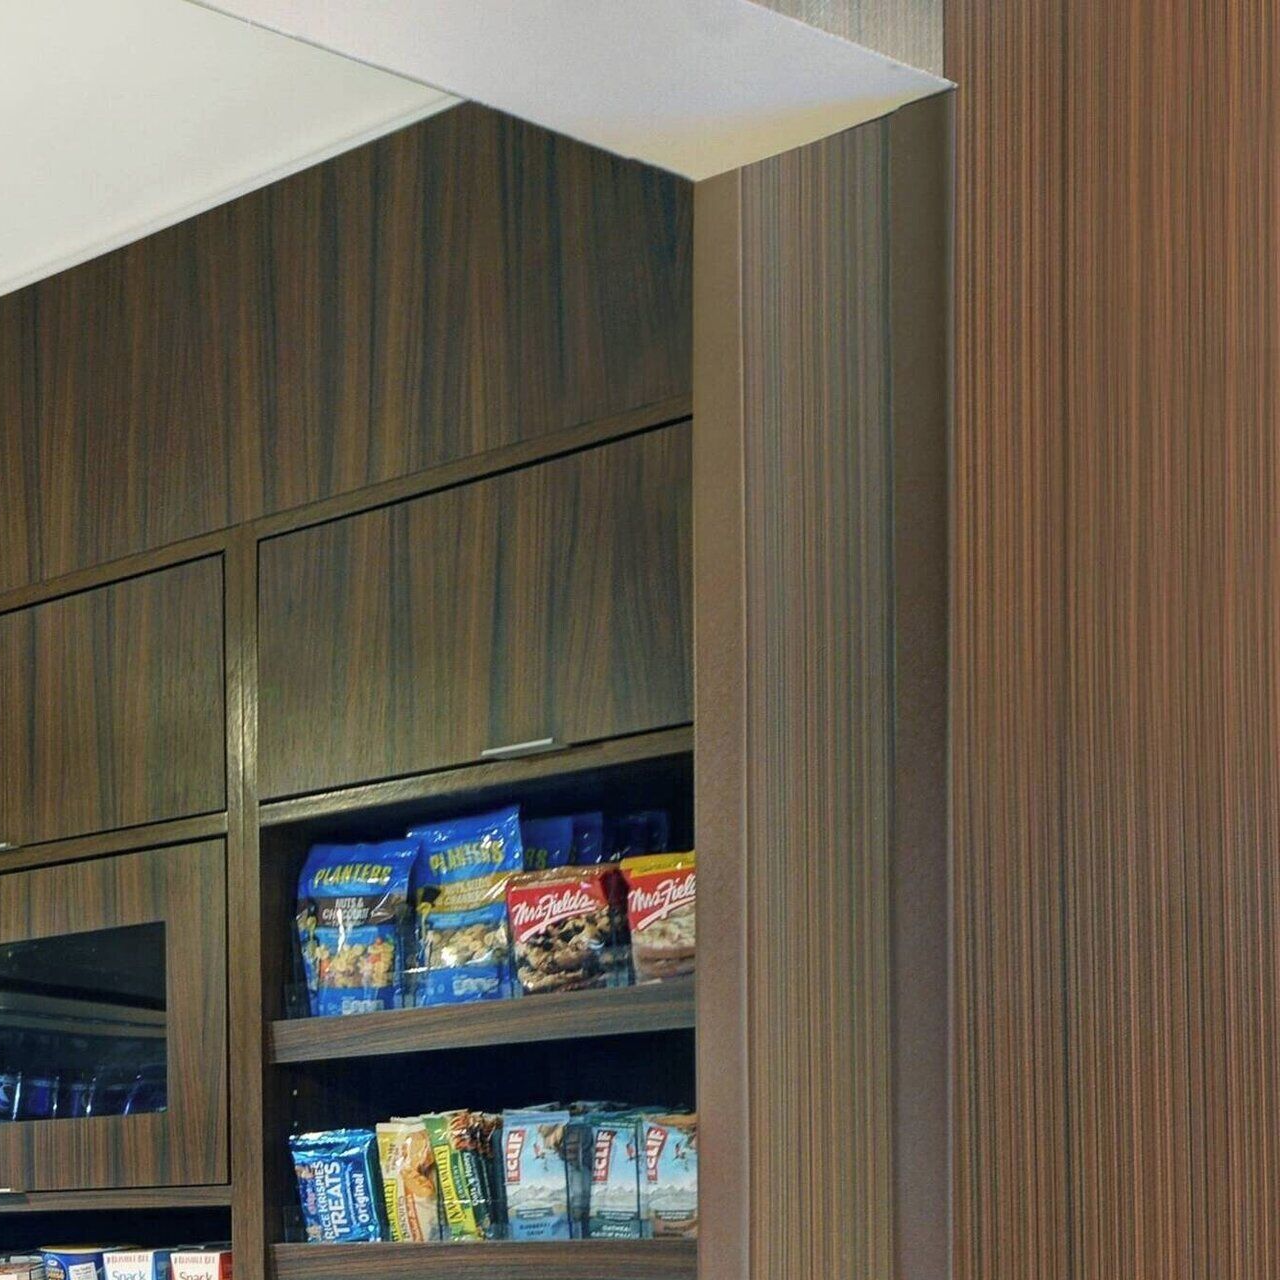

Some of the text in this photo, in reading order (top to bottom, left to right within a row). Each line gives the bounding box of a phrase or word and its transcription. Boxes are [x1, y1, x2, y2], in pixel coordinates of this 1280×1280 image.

[314, 863, 393, 888] PLANTERS
[322, 907, 370, 920] CHOCOLATE
[335, 897, 365, 908] NUTS &
[539, 889, 595, 923] Fields
[463, 1152, 474, 1177] Honey
[508, 1130, 523, 1171] CLIF
[595, 1131, 611, 1170] CLIF
[646, 1127, 666, 1169] CLIF
[314, 1161, 334, 1240] RICE KRISPIES
[325, 1162, 350, 1235] TREATS
[352, 1173, 370, 1223] Original
[437, 1149, 466, 1223] NATURE VALLEY
